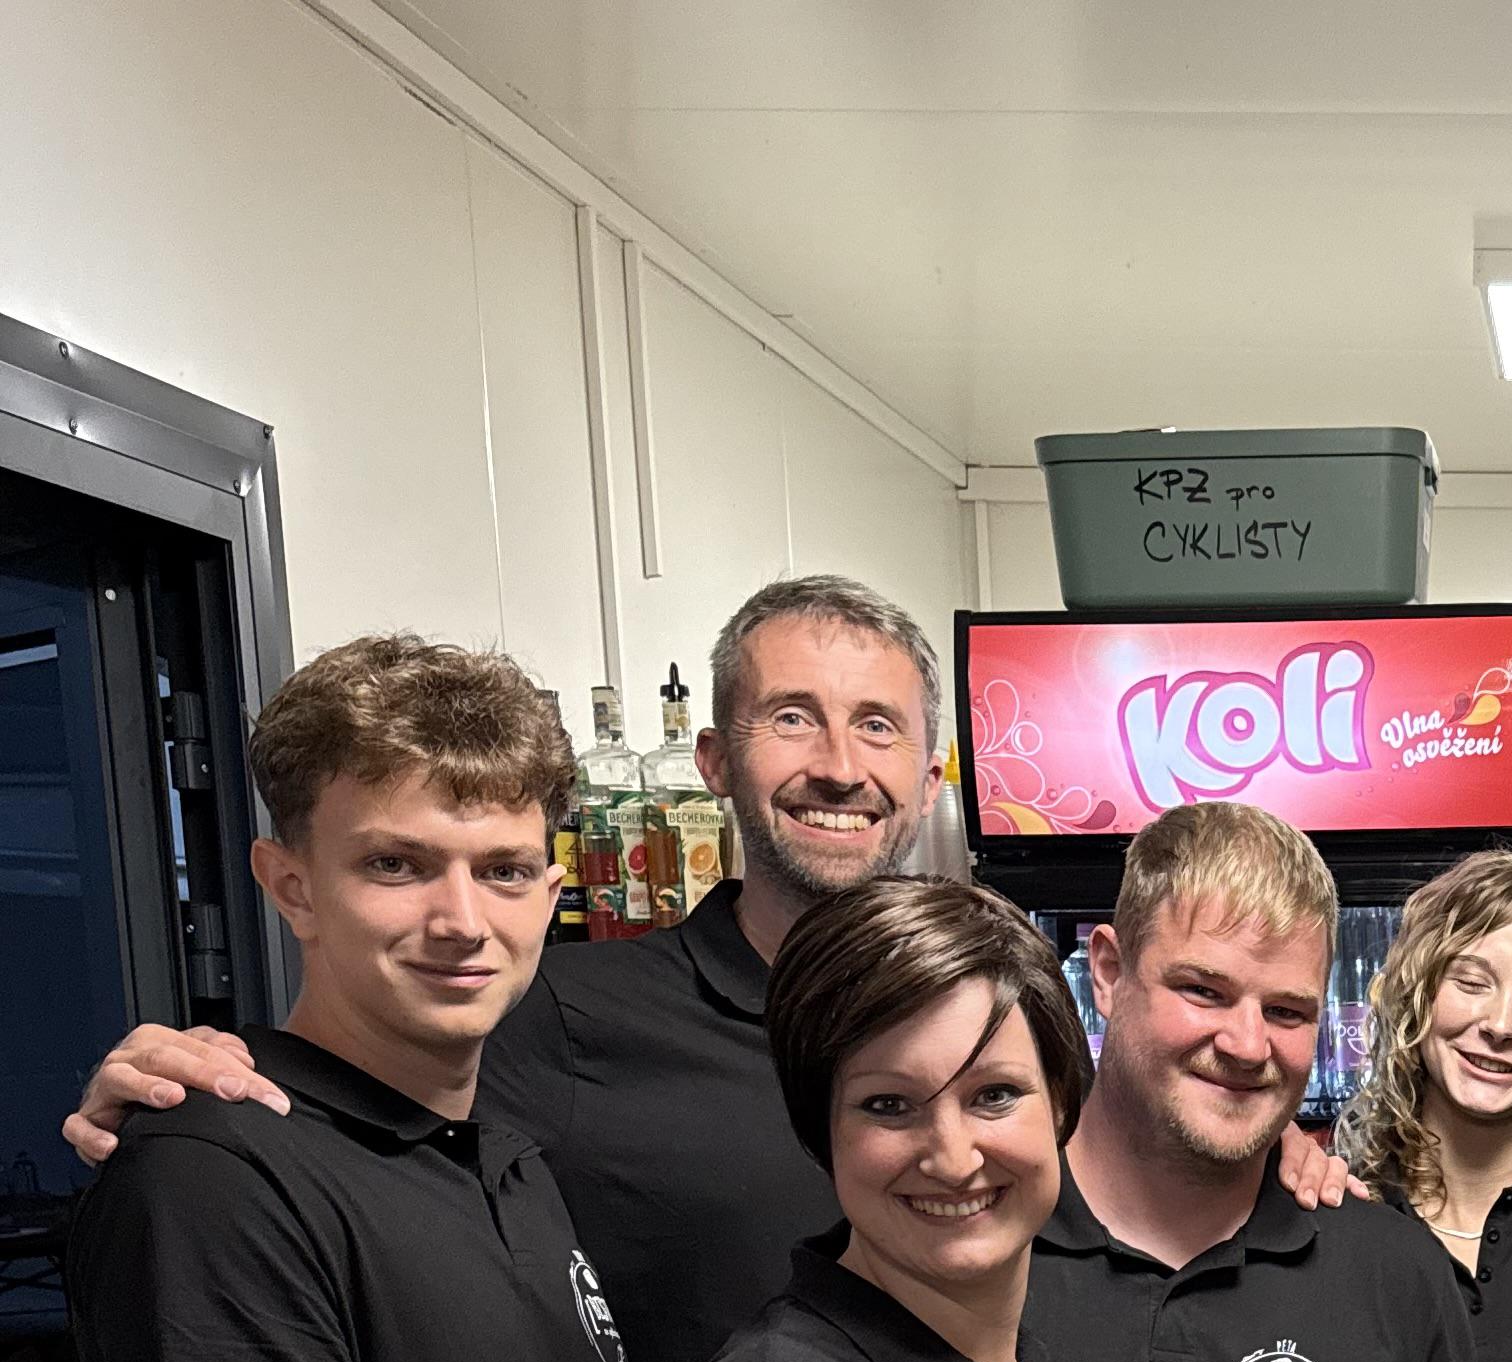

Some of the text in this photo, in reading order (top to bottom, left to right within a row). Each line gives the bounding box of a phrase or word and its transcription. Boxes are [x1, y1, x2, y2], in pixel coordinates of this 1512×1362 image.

[1226, 486, 1275, 511] pro
[1143, 520, 1312, 563] CYKLISTY
[1380, 710, 1446, 749] Vlna
[1402, 725, 1504, 768] osvěžení
